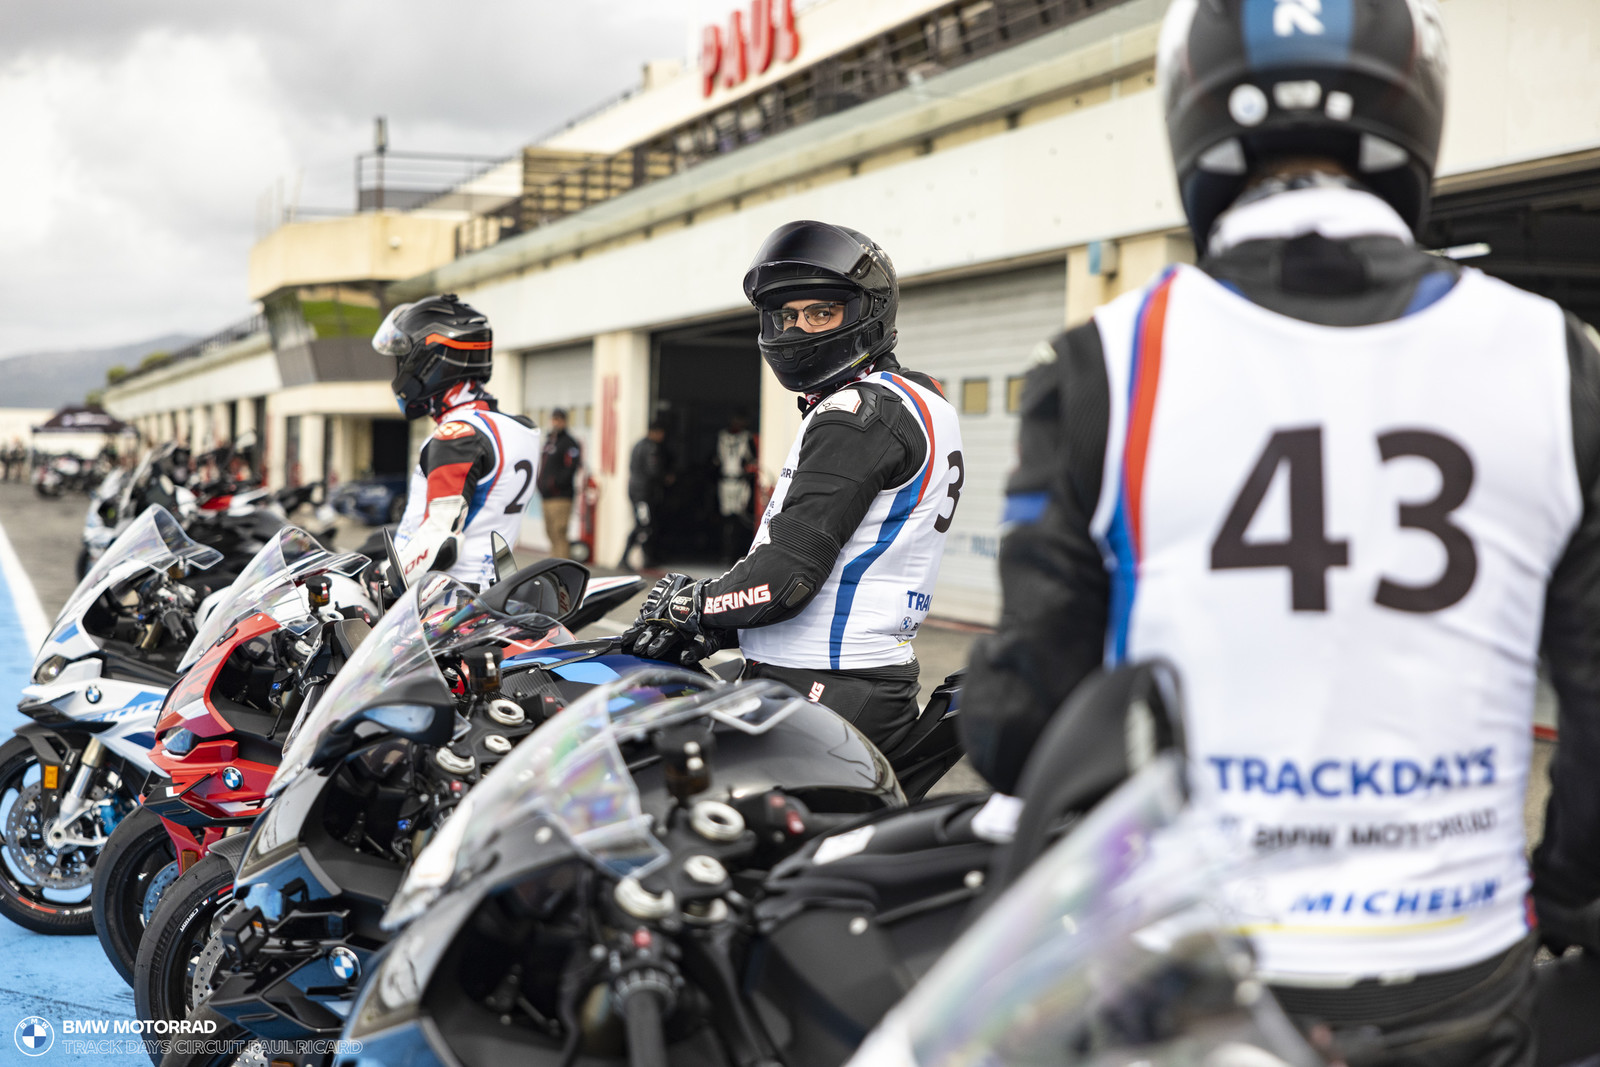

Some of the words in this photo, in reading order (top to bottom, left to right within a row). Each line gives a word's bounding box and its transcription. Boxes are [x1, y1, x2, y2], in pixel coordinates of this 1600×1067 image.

[503, 459, 533, 515] 2
[934, 450, 965, 534] 3
[1208, 422, 1480, 615] 43
[703, 583, 772, 615] BERING
[907, 590, 934, 612] TRA
[1207, 747, 1498, 798] TRACKDAYS
